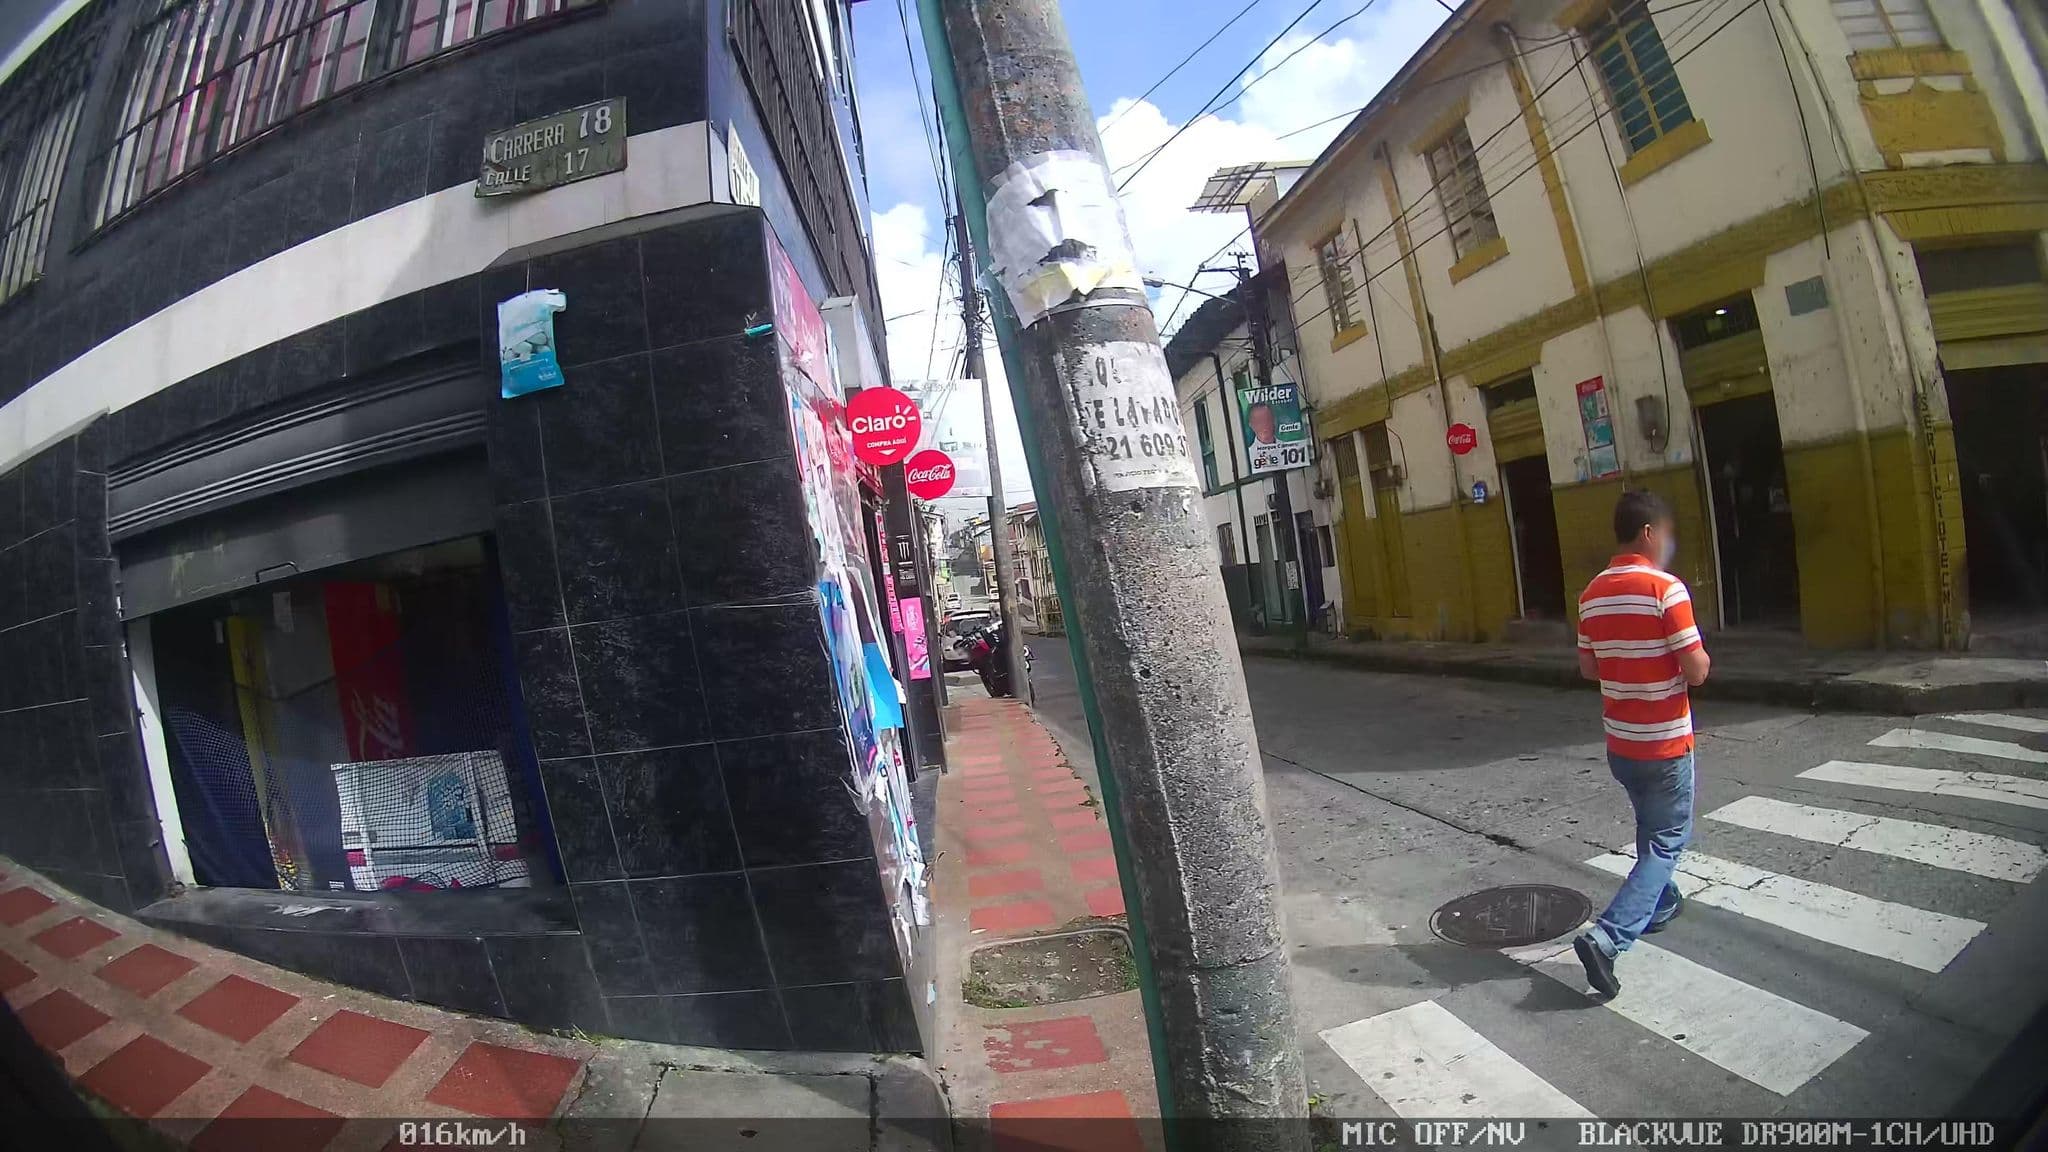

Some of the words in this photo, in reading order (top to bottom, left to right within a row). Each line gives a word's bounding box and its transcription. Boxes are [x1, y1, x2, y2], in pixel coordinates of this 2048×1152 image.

[490, 122, 565, 164] CARRERA
[579, 105, 613, 139] 18
[485, 164, 531, 186] CALLE
[563, 147, 590, 175] 17
[1244, 386, 1293, 405] Wilder
[852, 411, 910, 434] Claro
[867, 440, 892, 449] COMPRA
[1140, 432, 1176, 457] 609
[1280, 447, 1306, 465] 101
[908, 463, 953, 485] Coca-Cola
